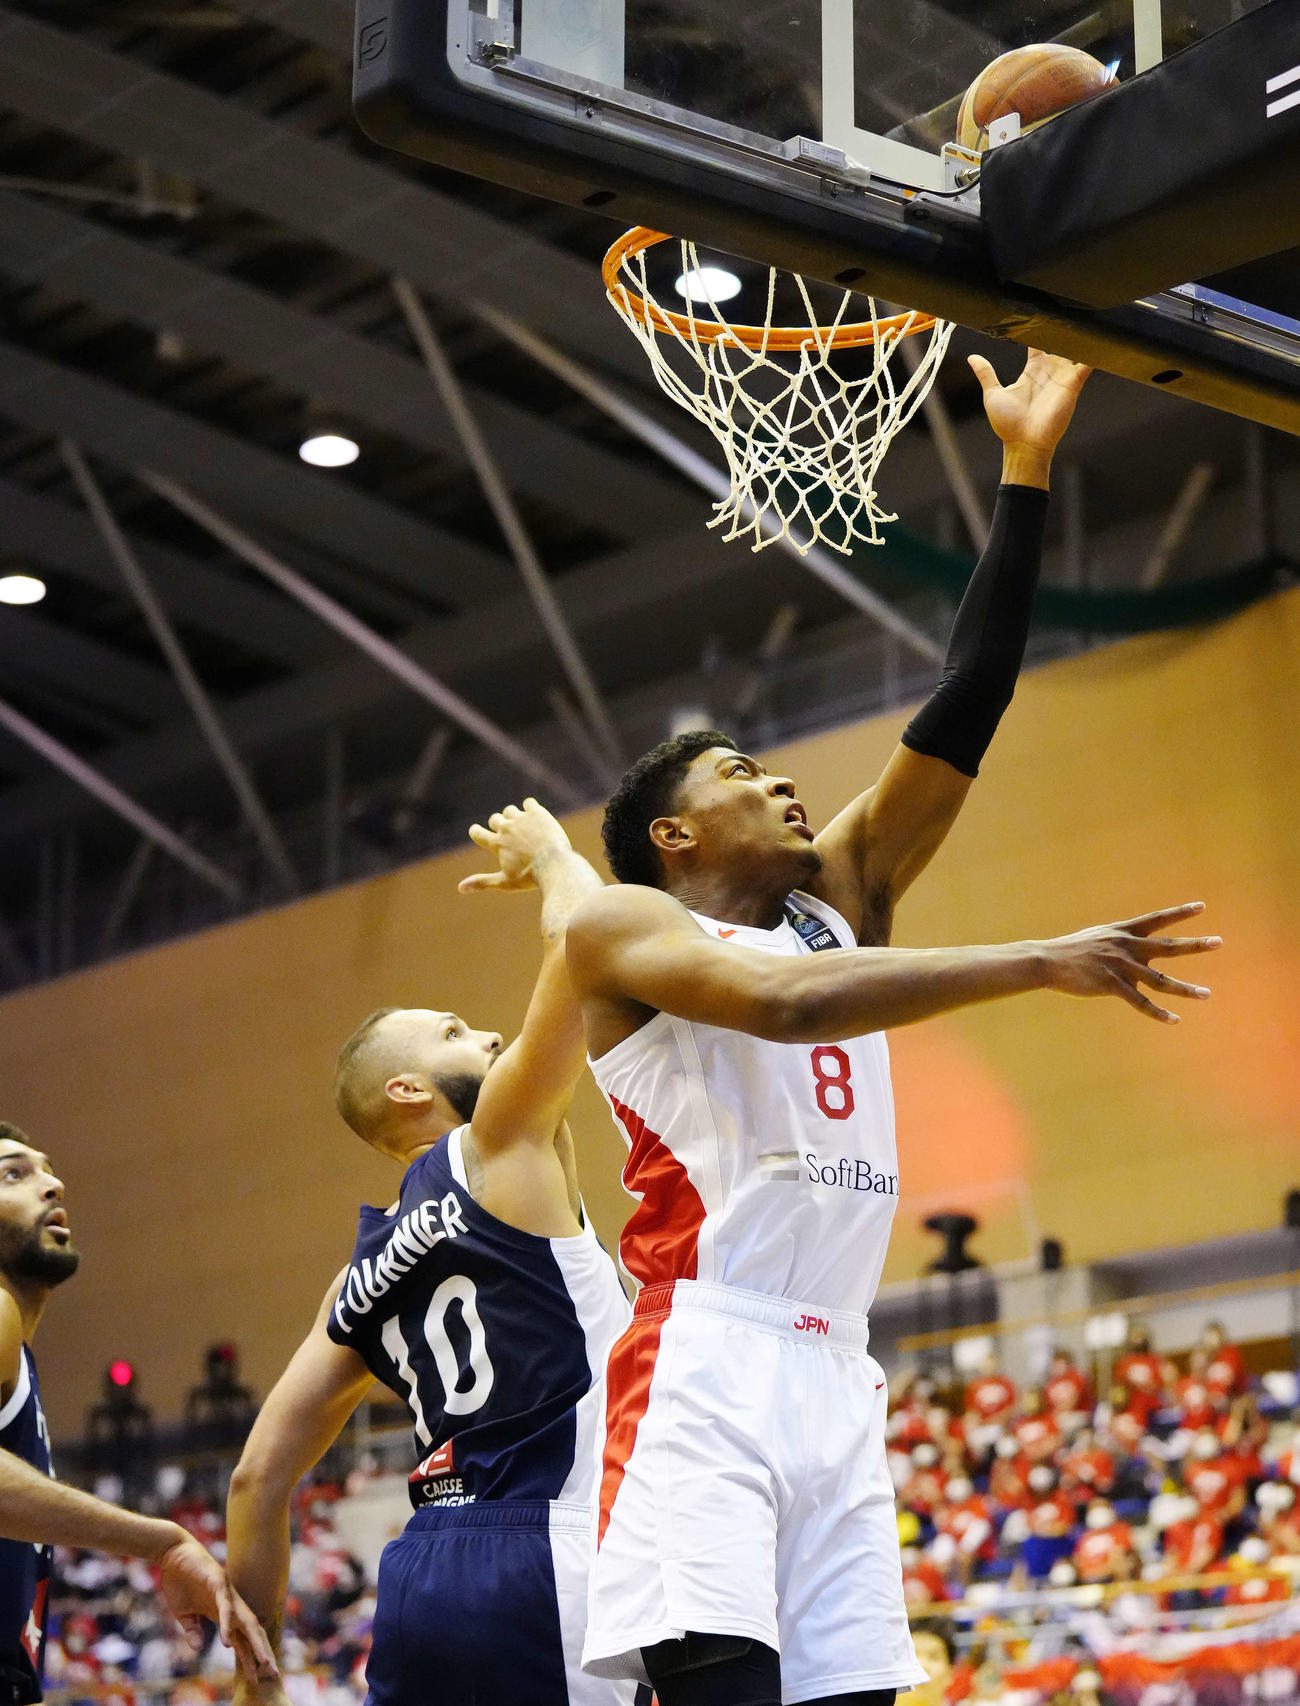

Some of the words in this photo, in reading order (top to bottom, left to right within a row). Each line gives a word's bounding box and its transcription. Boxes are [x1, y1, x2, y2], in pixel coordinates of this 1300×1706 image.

[811, 933, 832, 949] FIBA
[810, 1045, 855, 1120] 8
[793, 1314, 830, 1336] JPN
[381, 1275, 494, 1448] 10
[422, 1478, 464, 1499] CAISSE
